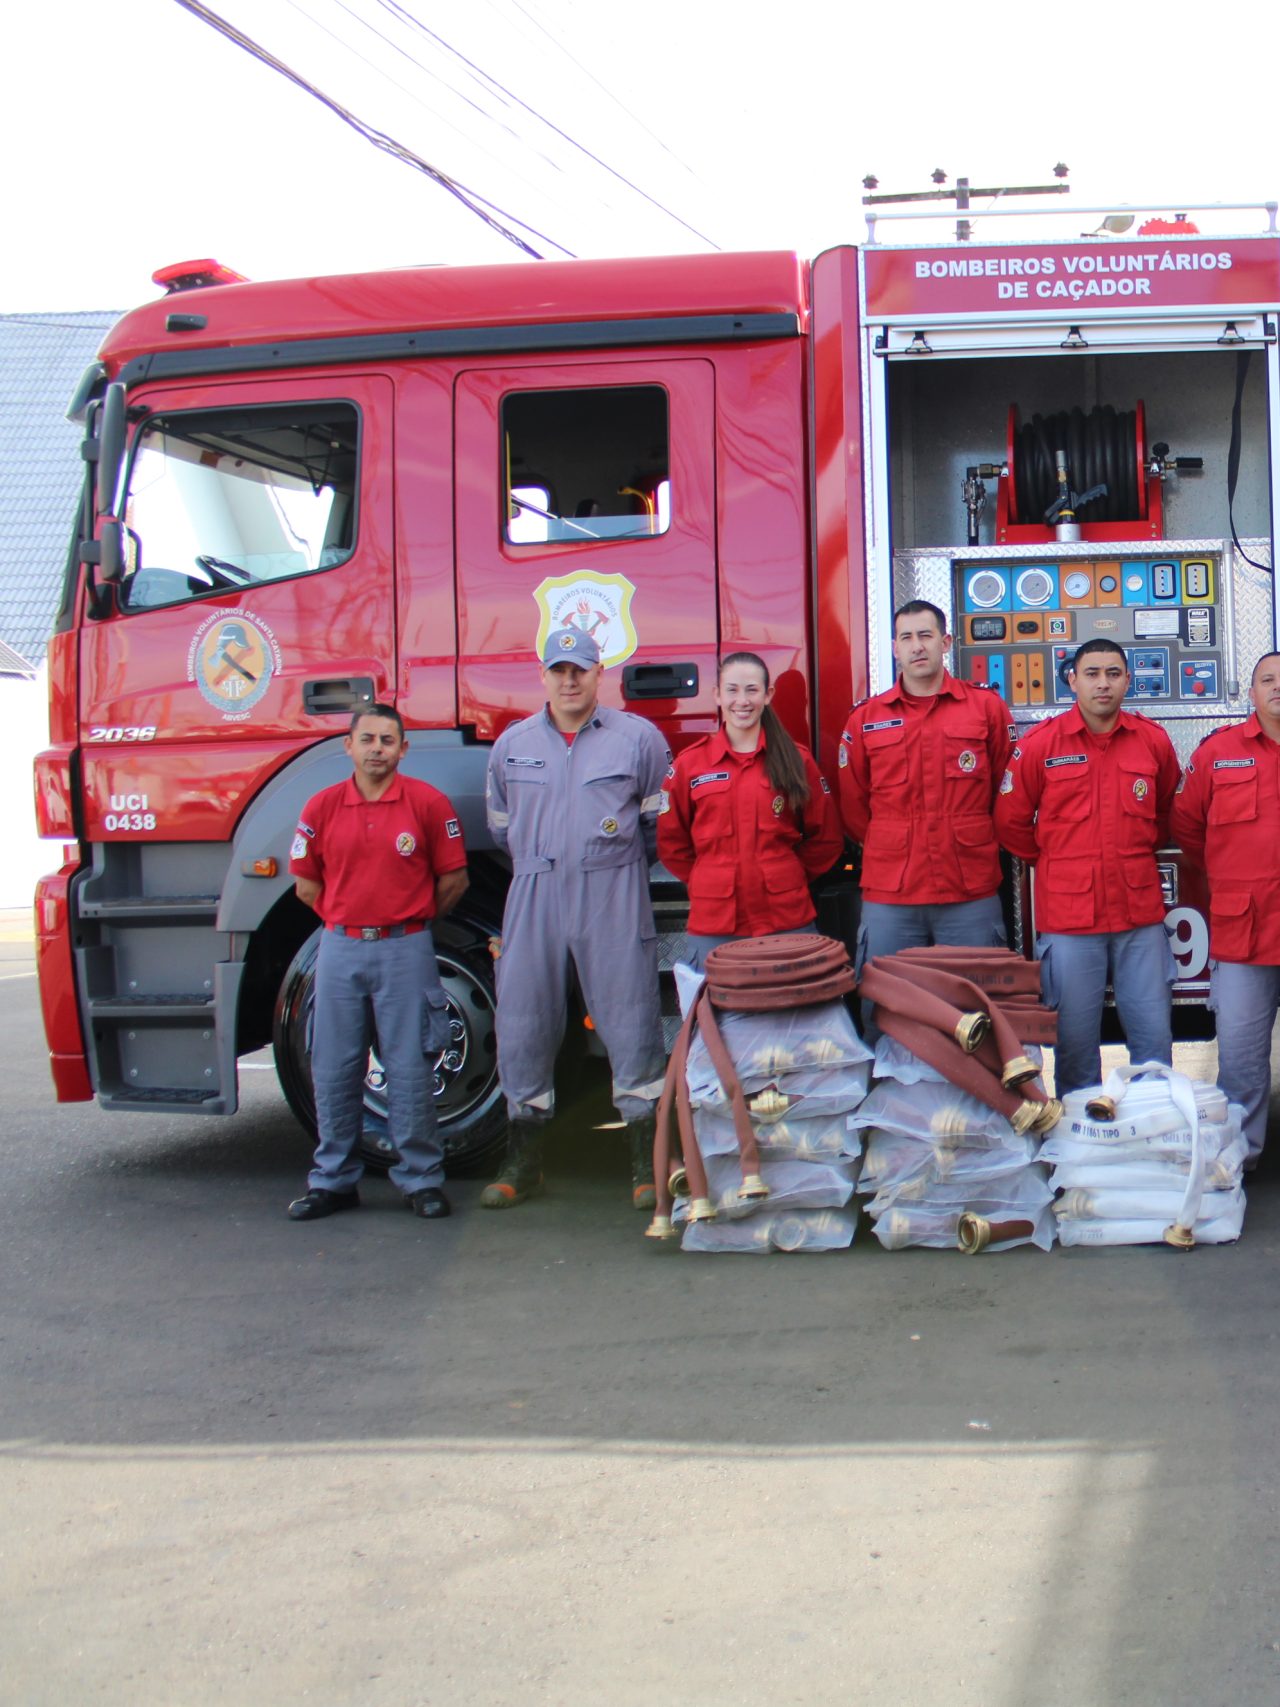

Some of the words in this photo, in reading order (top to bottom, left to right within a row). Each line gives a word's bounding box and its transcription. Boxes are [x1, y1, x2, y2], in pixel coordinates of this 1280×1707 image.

[915, 256, 1056, 278] BOMBEIROS
[1062, 250, 1233, 274] VOLUNTÁRIOS
[998, 280, 1029, 299] DE
[1035, 277, 1152, 301] CAÇADOR
[551, 588, 580, 621] BOMBEIROS
[580, 587, 618, 618] VOLUNTÁRIOS
[196, 607, 244, 637] VOLUNTÁRIOS
[244, 610, 257, 621] DE
[254, 617, 275, 641] SANTA
[270, 638, 283, 676] CATARINA
[89, 726, 157, 742] 2036
[110, 794, 149, 811] UCI
[105, 813, 156, 831] 0438
